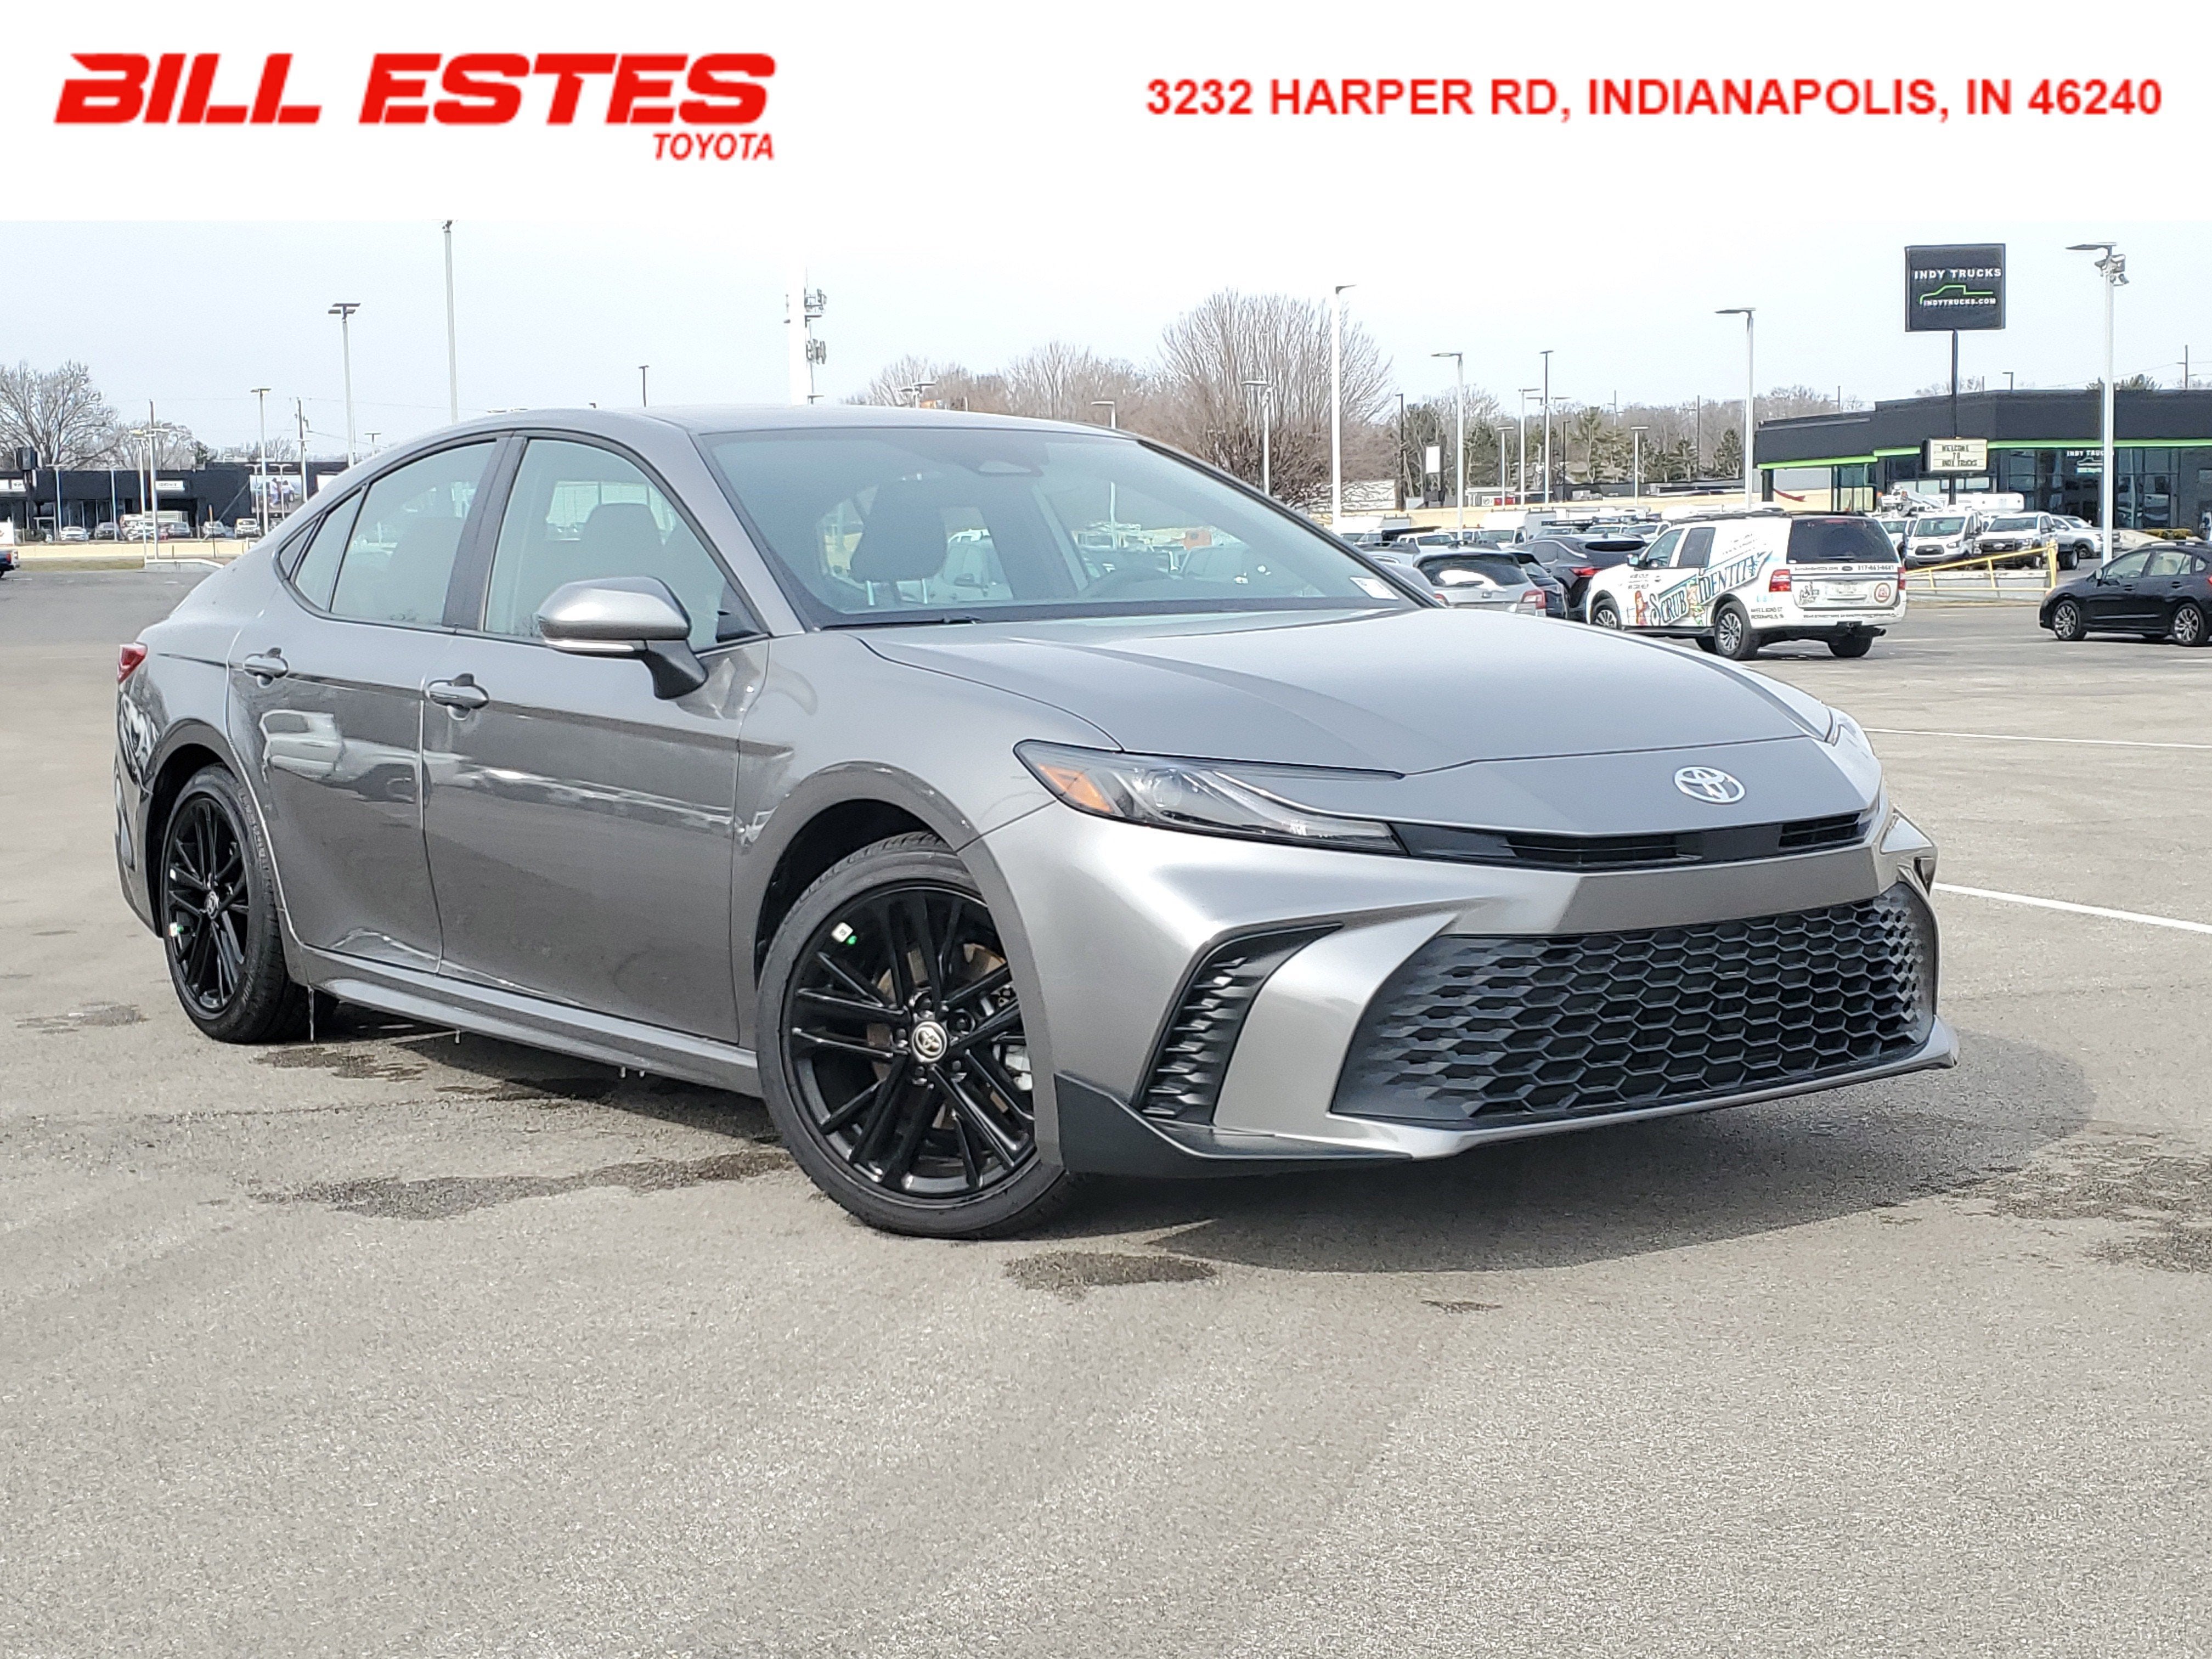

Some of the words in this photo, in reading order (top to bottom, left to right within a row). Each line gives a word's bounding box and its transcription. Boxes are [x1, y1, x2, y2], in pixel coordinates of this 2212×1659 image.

[1914, 269, 1945, 280] INDY
[1949, 268, 2002, 279] TRUCKS
[1649, 588, 1688, 627] SCRUB
